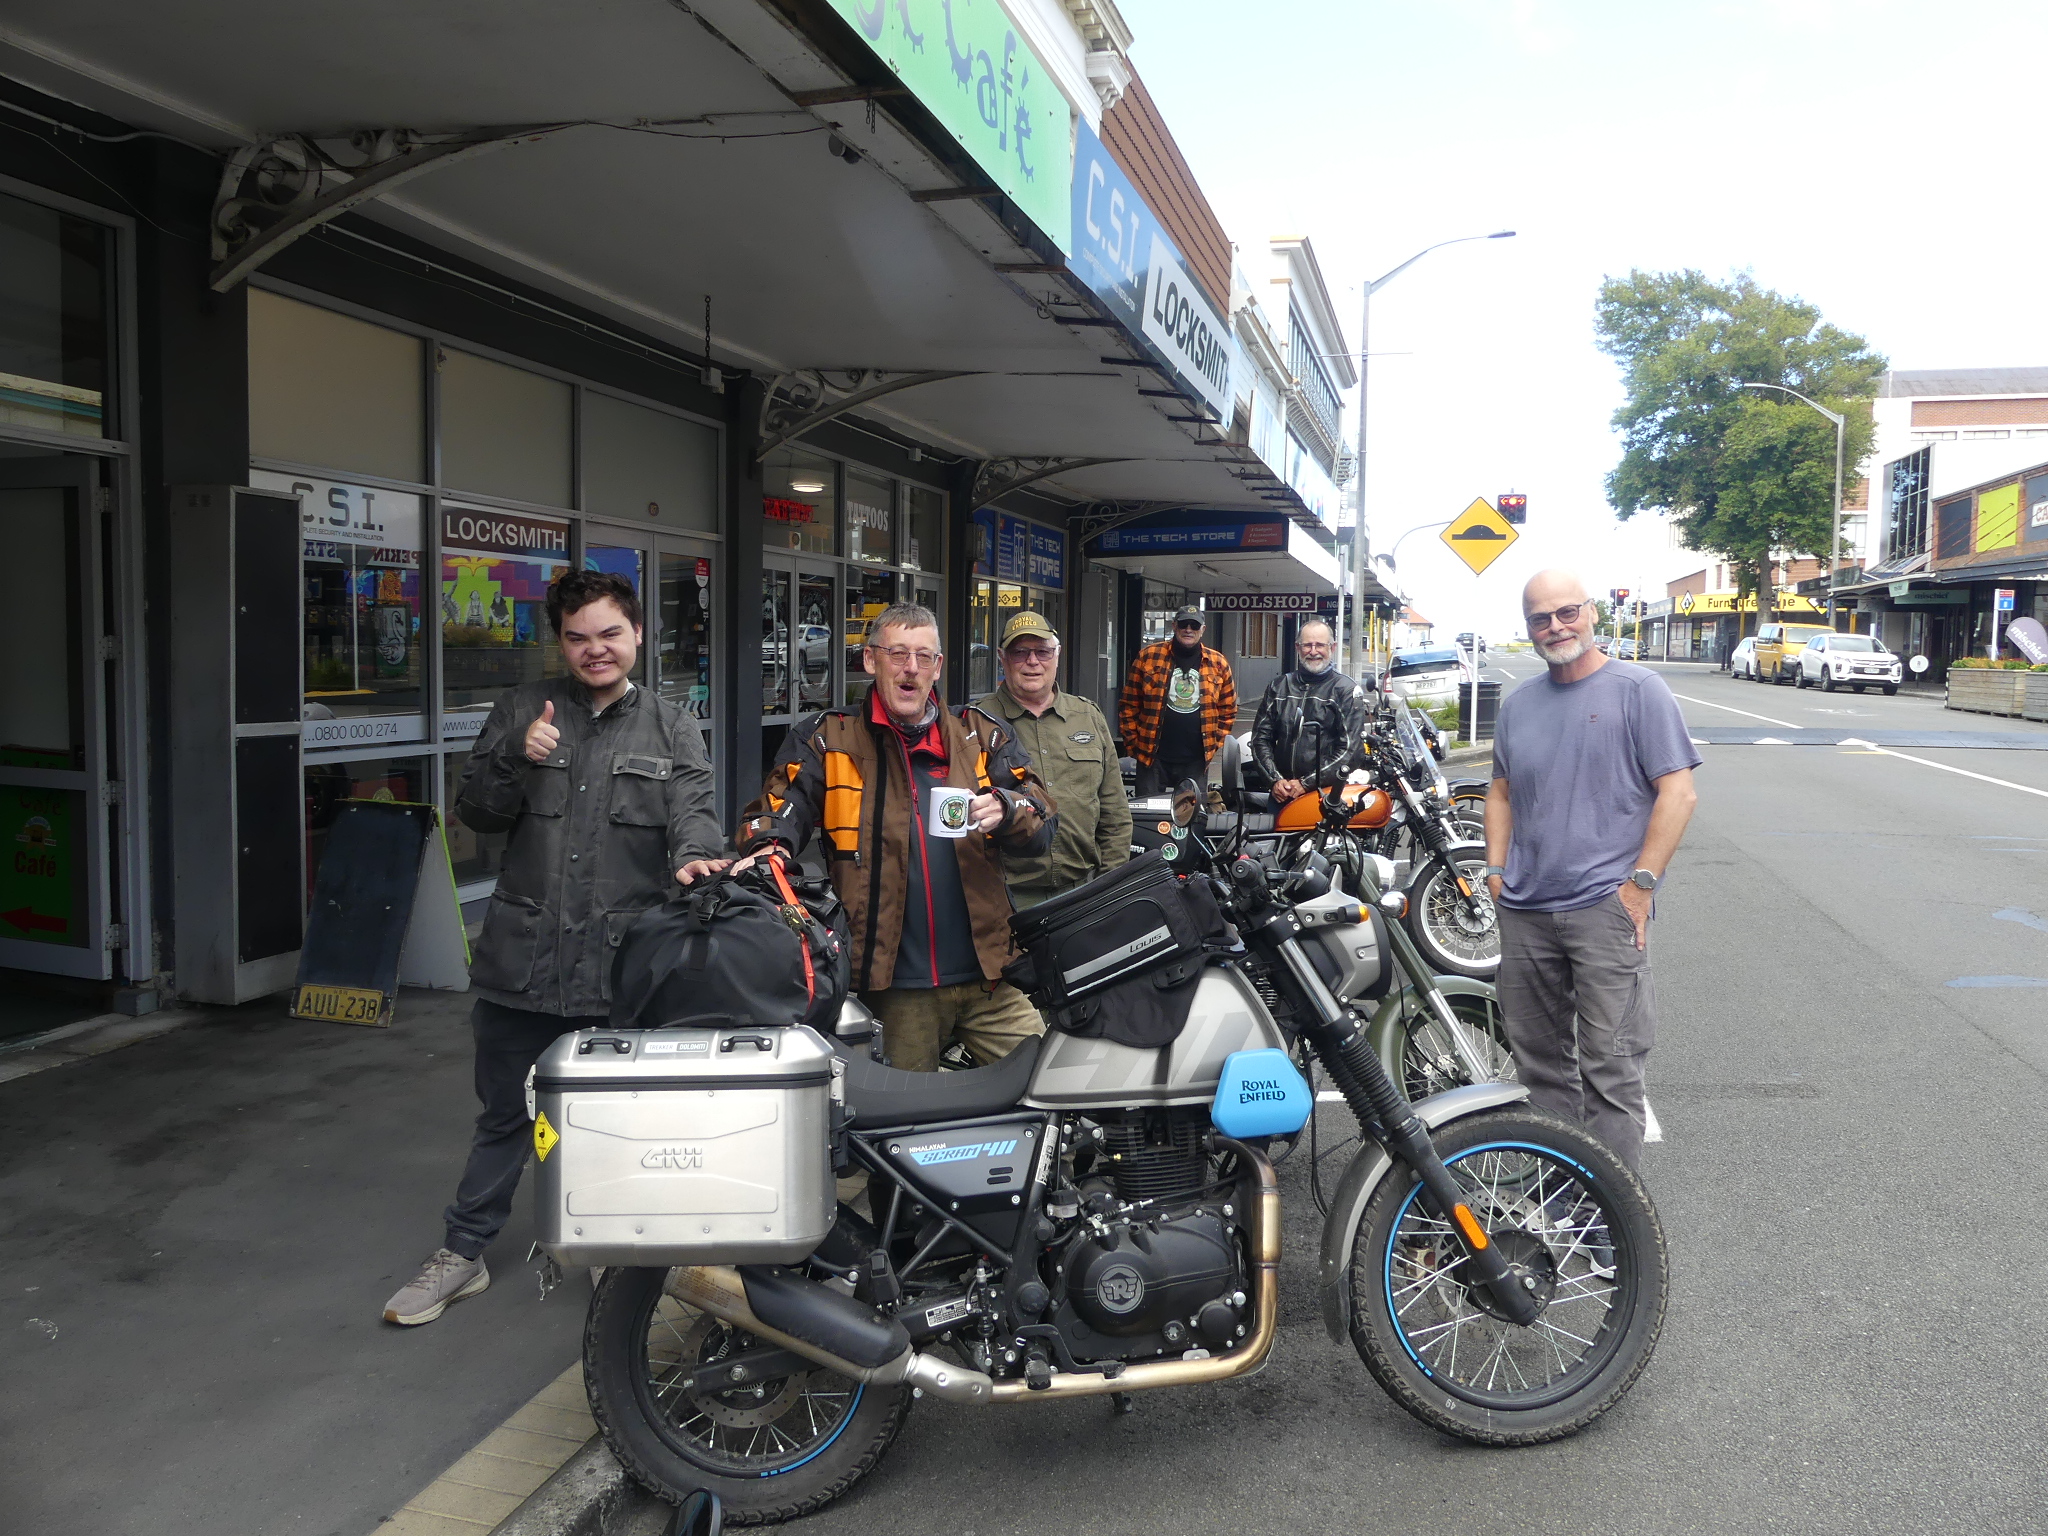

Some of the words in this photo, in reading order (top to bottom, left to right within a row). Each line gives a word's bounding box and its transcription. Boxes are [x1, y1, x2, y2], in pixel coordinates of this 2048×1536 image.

[1086, 159, 1139, 289] C.S.I.
[847, 500, 888, 532] TATTOOS
[318, 528, 341, 537] SECURITY
[353, 532, 384, 541] INSTALLATION
[446, 515, 565, 551] LOCKSMITH
[1030, 533, 1044, 550] THE
[1044, 538, 1060, 554] TECH
[1123, 535, 1149, 543] THE
[1153, 533, 1188, 542] TECH
[1191, 531, 1236, 541] STORE
[1030, 554, 1060, 578] STORE
[1208, 596, 1313, 609] WOOLSHOP
[2010, 626, 2048, 661] mischief
[350, 724, 373, 739] 000
[376, 723, 398, 737] 274
[14, 850, 57, 878] Café
[1129, 933, 1162, 953] LOUIS
[1241, 1080, 1280, 1091] ROYAL
[1239, 1090, 1286, 1104] ENFIELD
[641, 1147, 702, 1169] GIVI
[909, 1143, 946, 1154] HIMALAYAN
[921, 1148, 978, 1163] SCRAM
[982, 1139, 1018, 1157] 411
